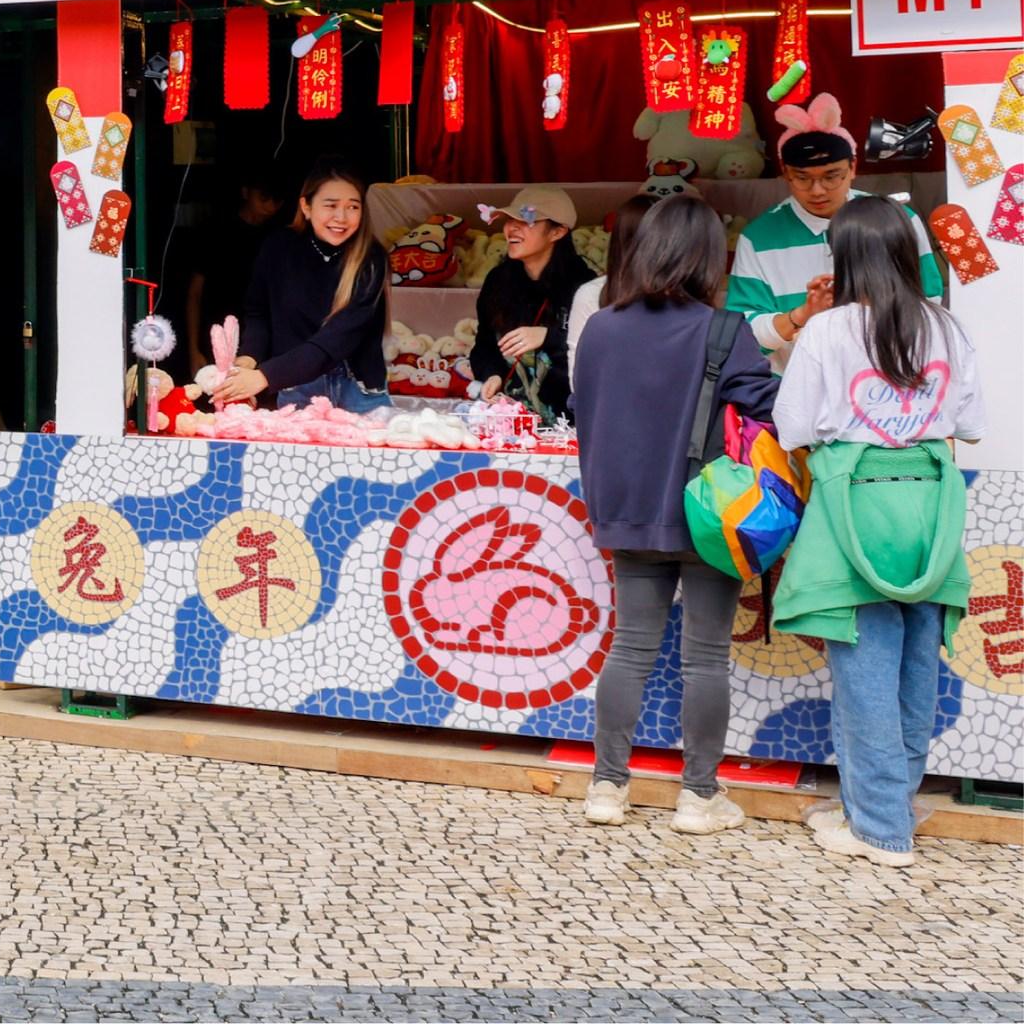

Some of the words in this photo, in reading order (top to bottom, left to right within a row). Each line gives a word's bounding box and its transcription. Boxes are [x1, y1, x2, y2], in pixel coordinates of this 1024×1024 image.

[311, 47, 330, 109] 明伶俐
[656, 10, 683, 100] 出入安
[704, 64, 727, 129] 精神
